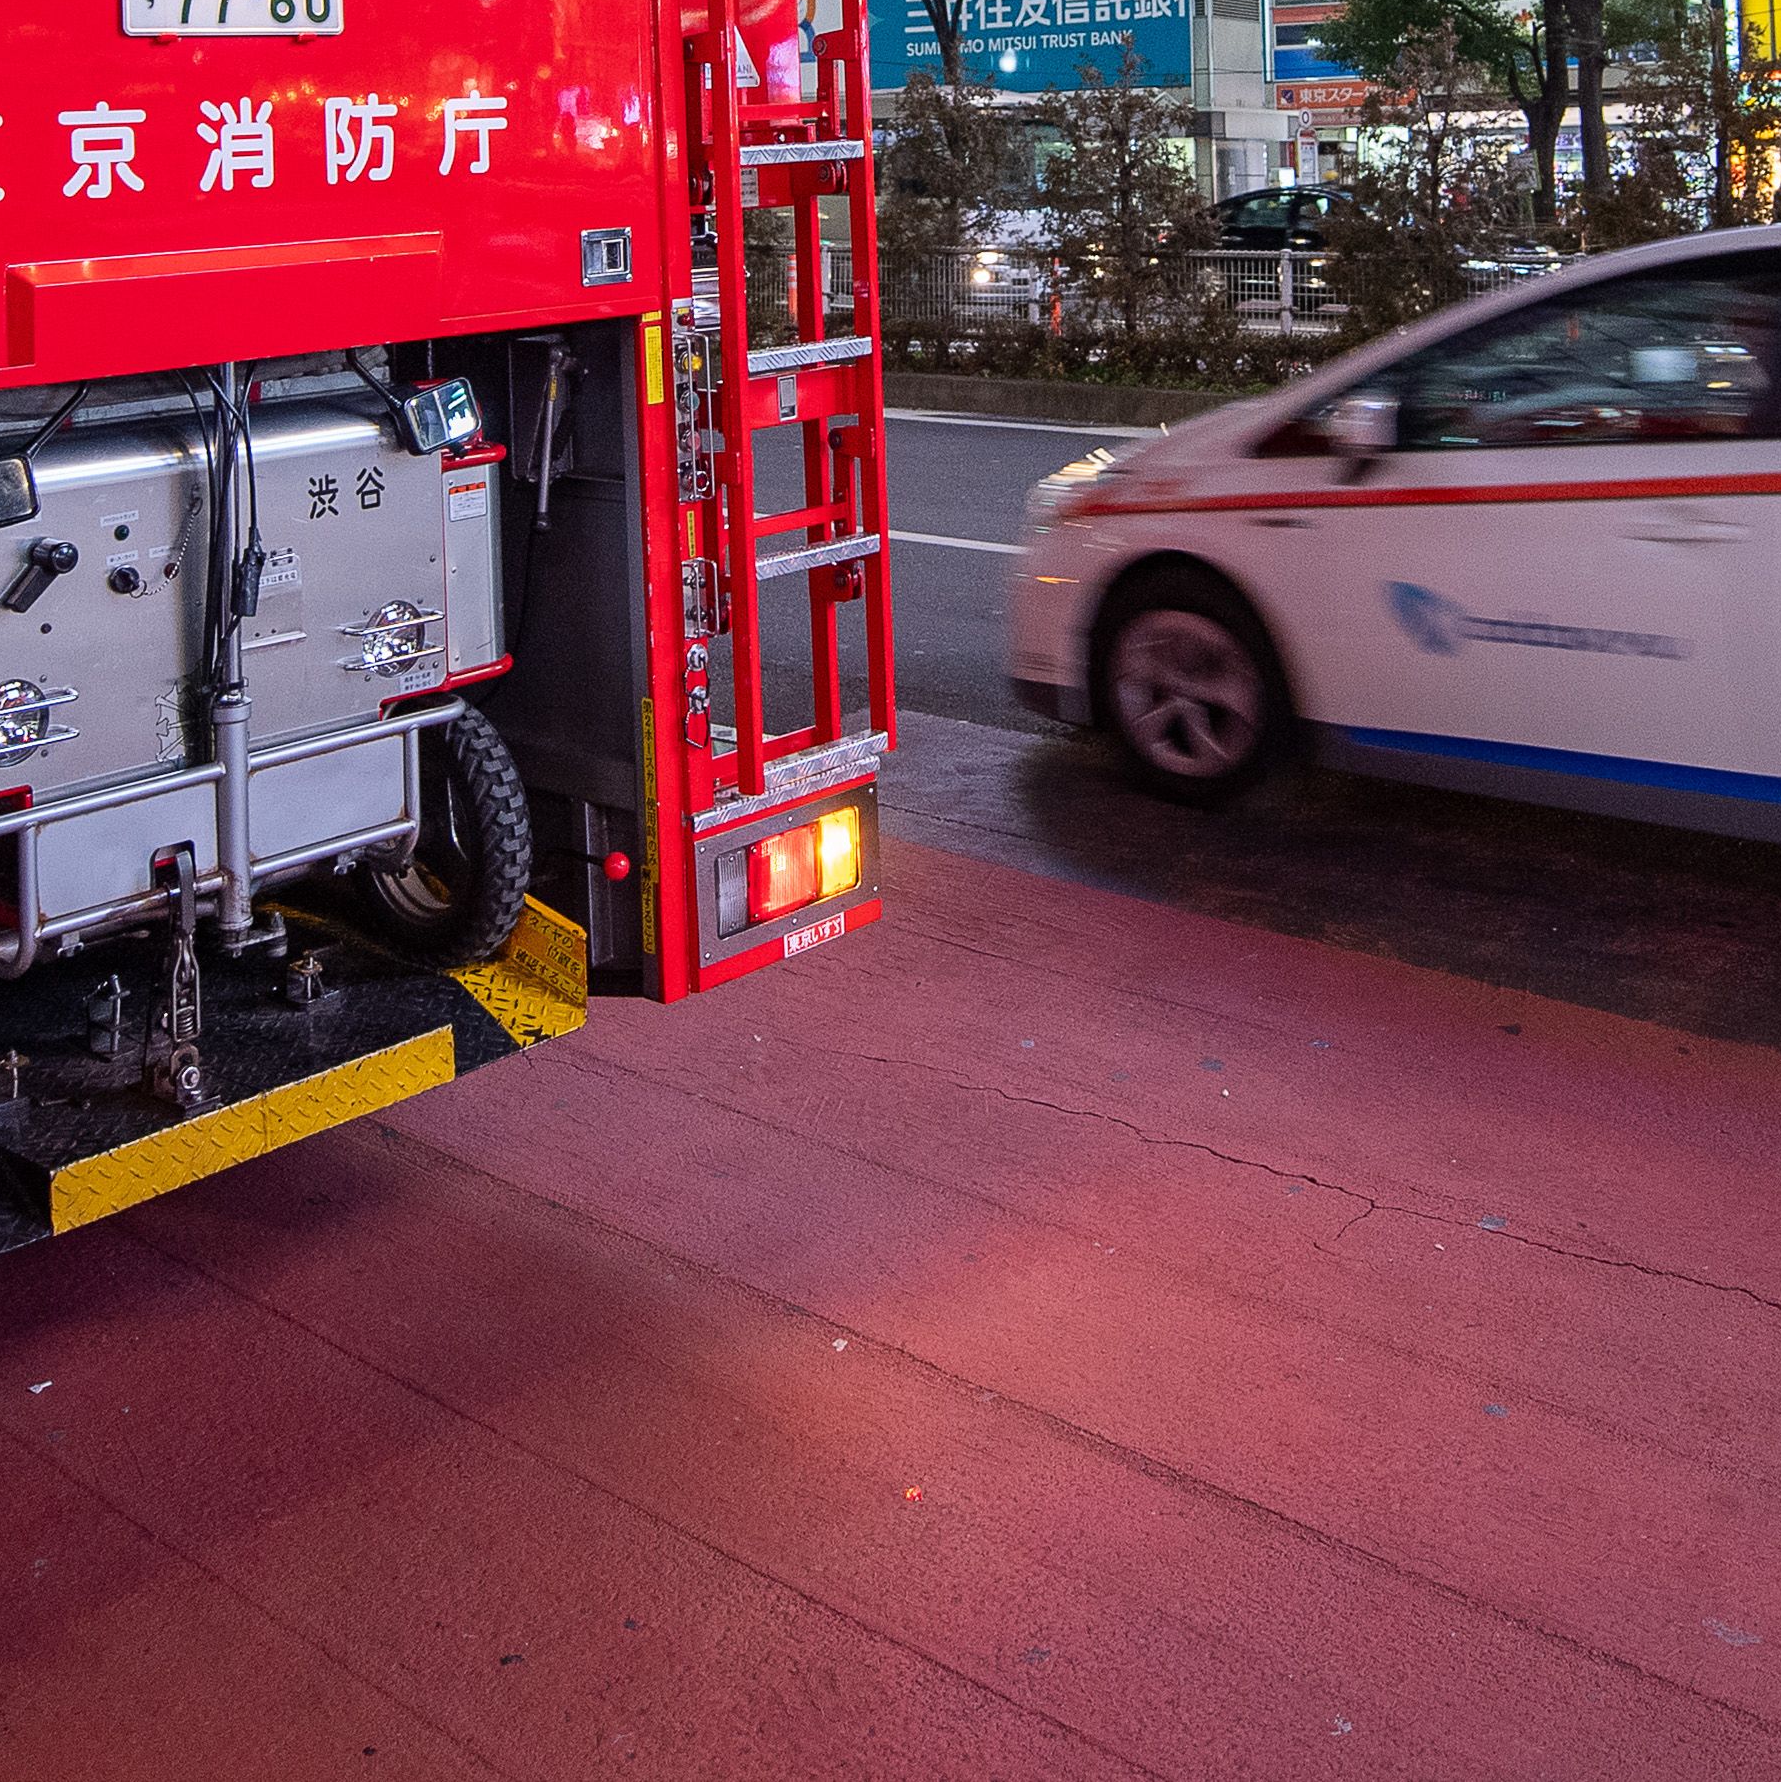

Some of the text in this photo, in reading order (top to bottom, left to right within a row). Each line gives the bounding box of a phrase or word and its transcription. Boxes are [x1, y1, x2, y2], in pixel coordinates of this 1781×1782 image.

[988, 34, 1037, 53] MITSUI
[1040, 31, 1086, 50] TRUST
[1091, 29, 1133, 47] BANK
[308, 466, 387, 521] 渋谷
[529, 915, 574, 950] タイヤの
